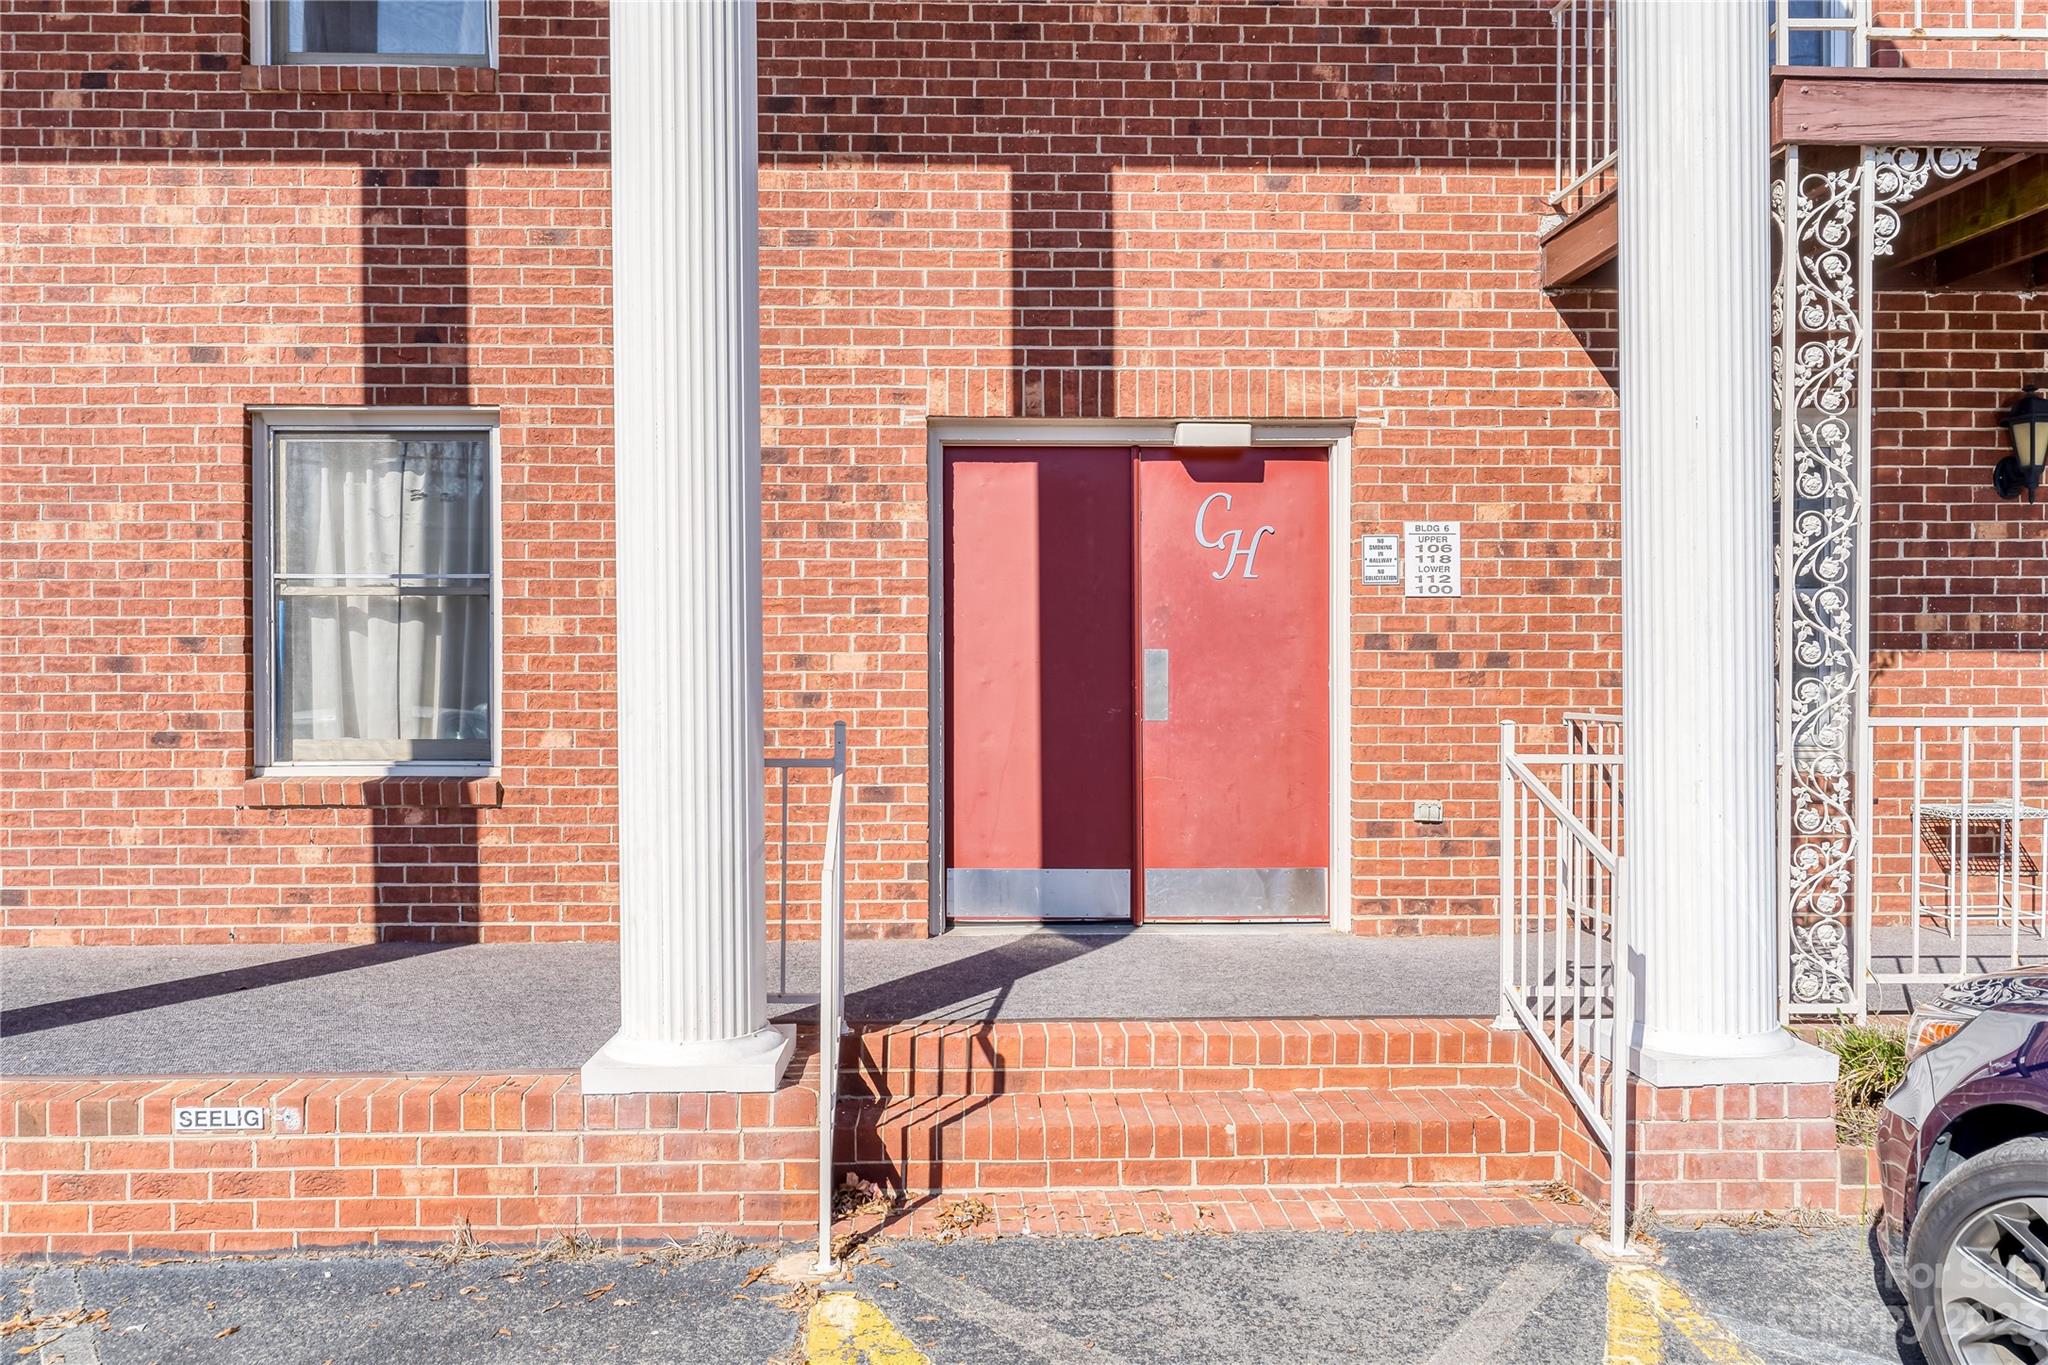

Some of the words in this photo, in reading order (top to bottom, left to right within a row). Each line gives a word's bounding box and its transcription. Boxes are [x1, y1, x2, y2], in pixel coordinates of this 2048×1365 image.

[1415, 544, 1453, 553] 106
[1415, 555, 1452, 564] 118
[1415, 575, 1451, 583] 112
[1415, 585, 1453, 594] 100
[179, 1110, 259, 1127] SEELIG
